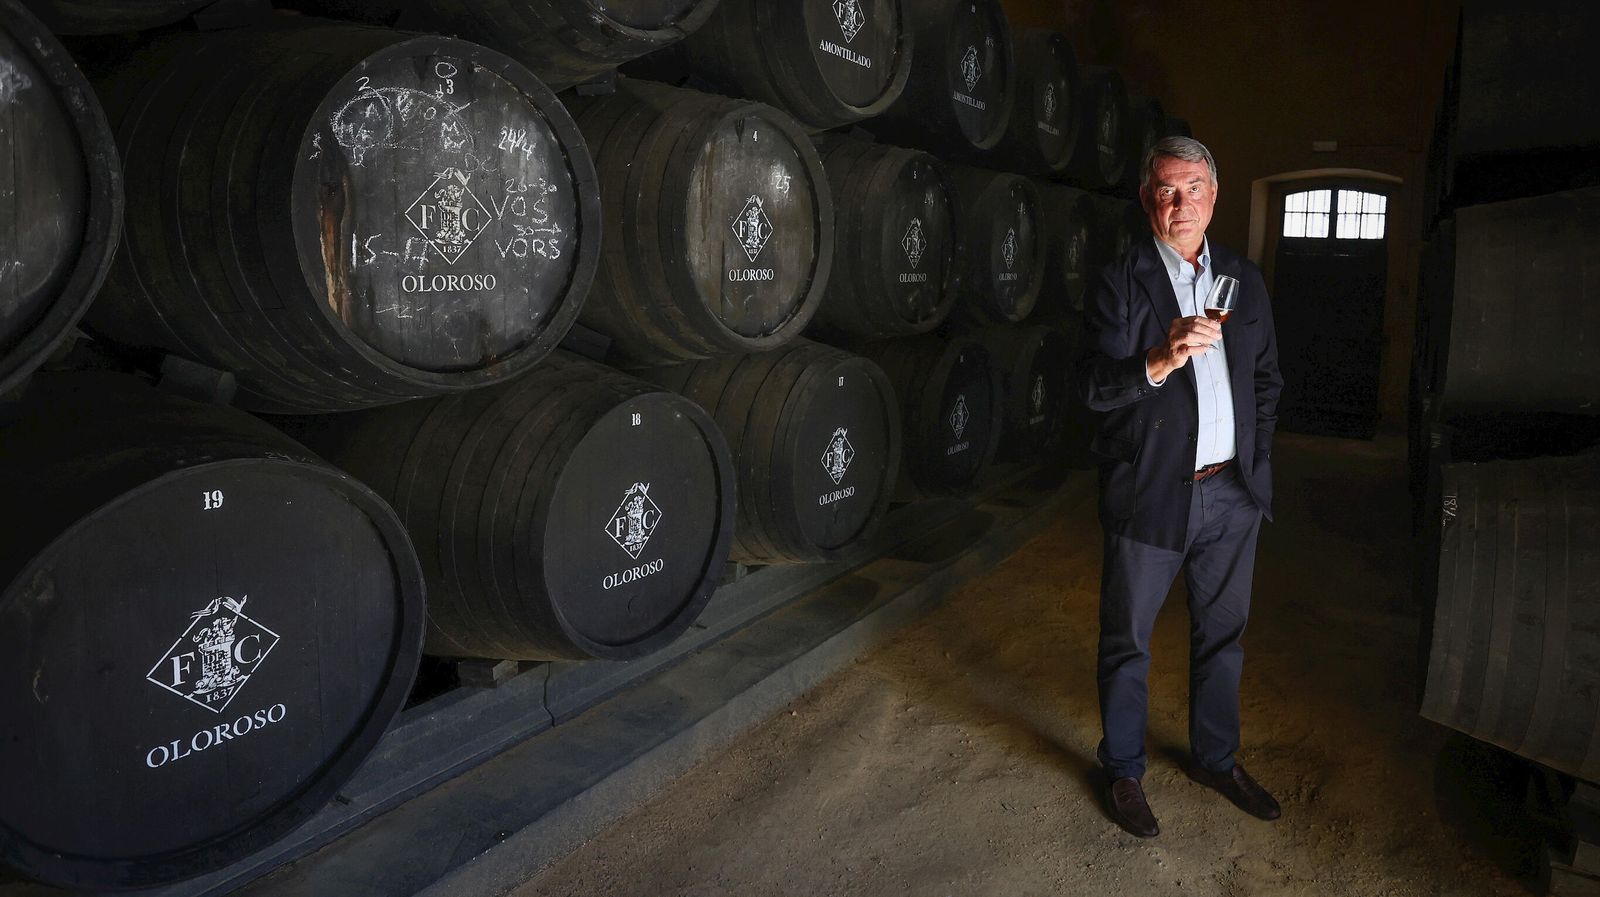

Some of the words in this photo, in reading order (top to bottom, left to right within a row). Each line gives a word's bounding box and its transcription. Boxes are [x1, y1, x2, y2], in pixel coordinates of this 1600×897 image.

[819, 40, 871, 69] AMONTILLADO
[446, 79, 454, 95] 3
[752, 130, 758, 142] 4
[420, 204, 436, 230] F
[462, 207, 481, 232] C
[490, 195, 549, 225] VOS
[443, 245, 462, 254] 1837
[494, 236, 561, 260] VORS
[401, 273, 497, 293] OLOROSO
[728, 268, 775, 282] OLOROSO
[631, 412, 642, 427] 18
[202, 489, 224, 511] 19
[819, 485, 856, 506] OLOROSO
[615, 516, 627, 538] F
[642, 509, 655, 530] C
[602, 558, 665, 590] OLOROSO
[170, 652, 195, 688] F
[233, 633, 262, 664] C
[205, 686, 235, 703] 1837
[145, 703, 287, 769] OLOROSO
